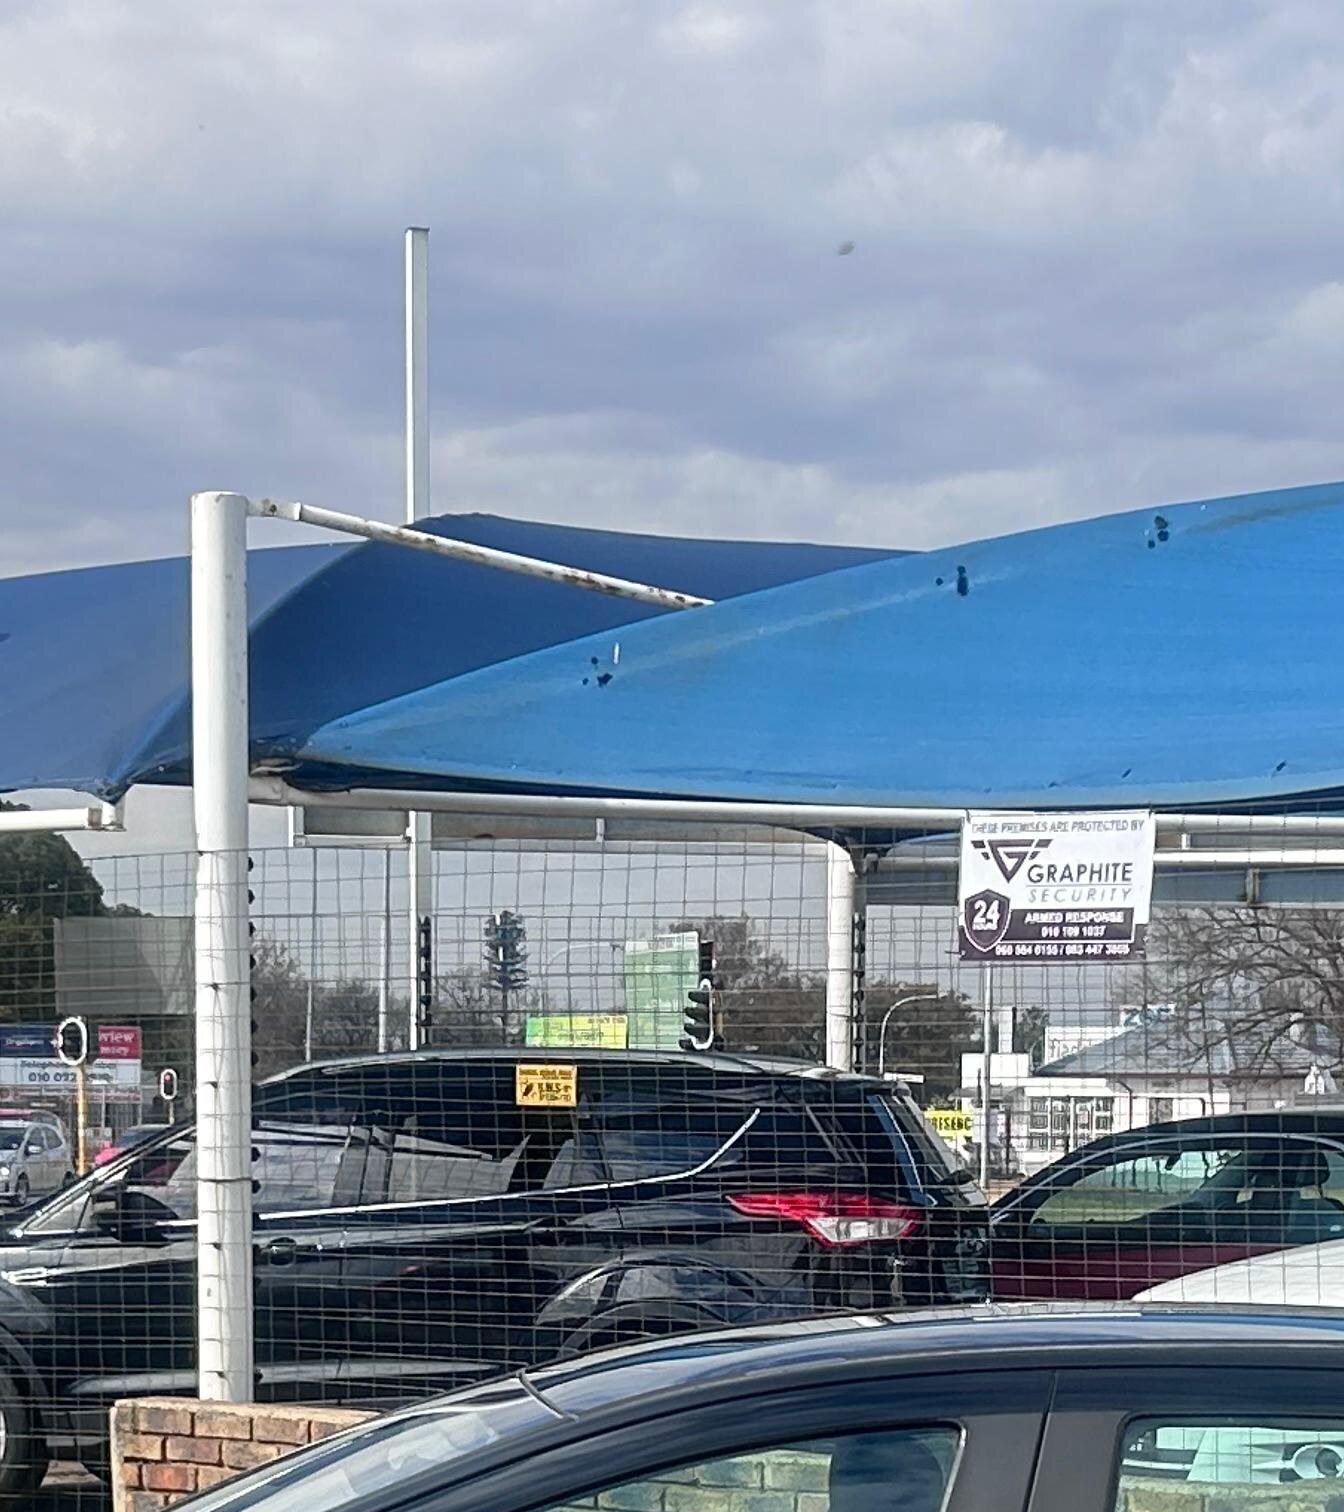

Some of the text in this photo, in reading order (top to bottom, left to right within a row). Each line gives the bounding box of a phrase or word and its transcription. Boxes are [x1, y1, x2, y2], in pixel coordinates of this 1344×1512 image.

[1027, 862, 1133, 883] GRAPHITE
[1028, 887, 1133, 903] SECURITY
[973, 900, 1000, 924] 24
